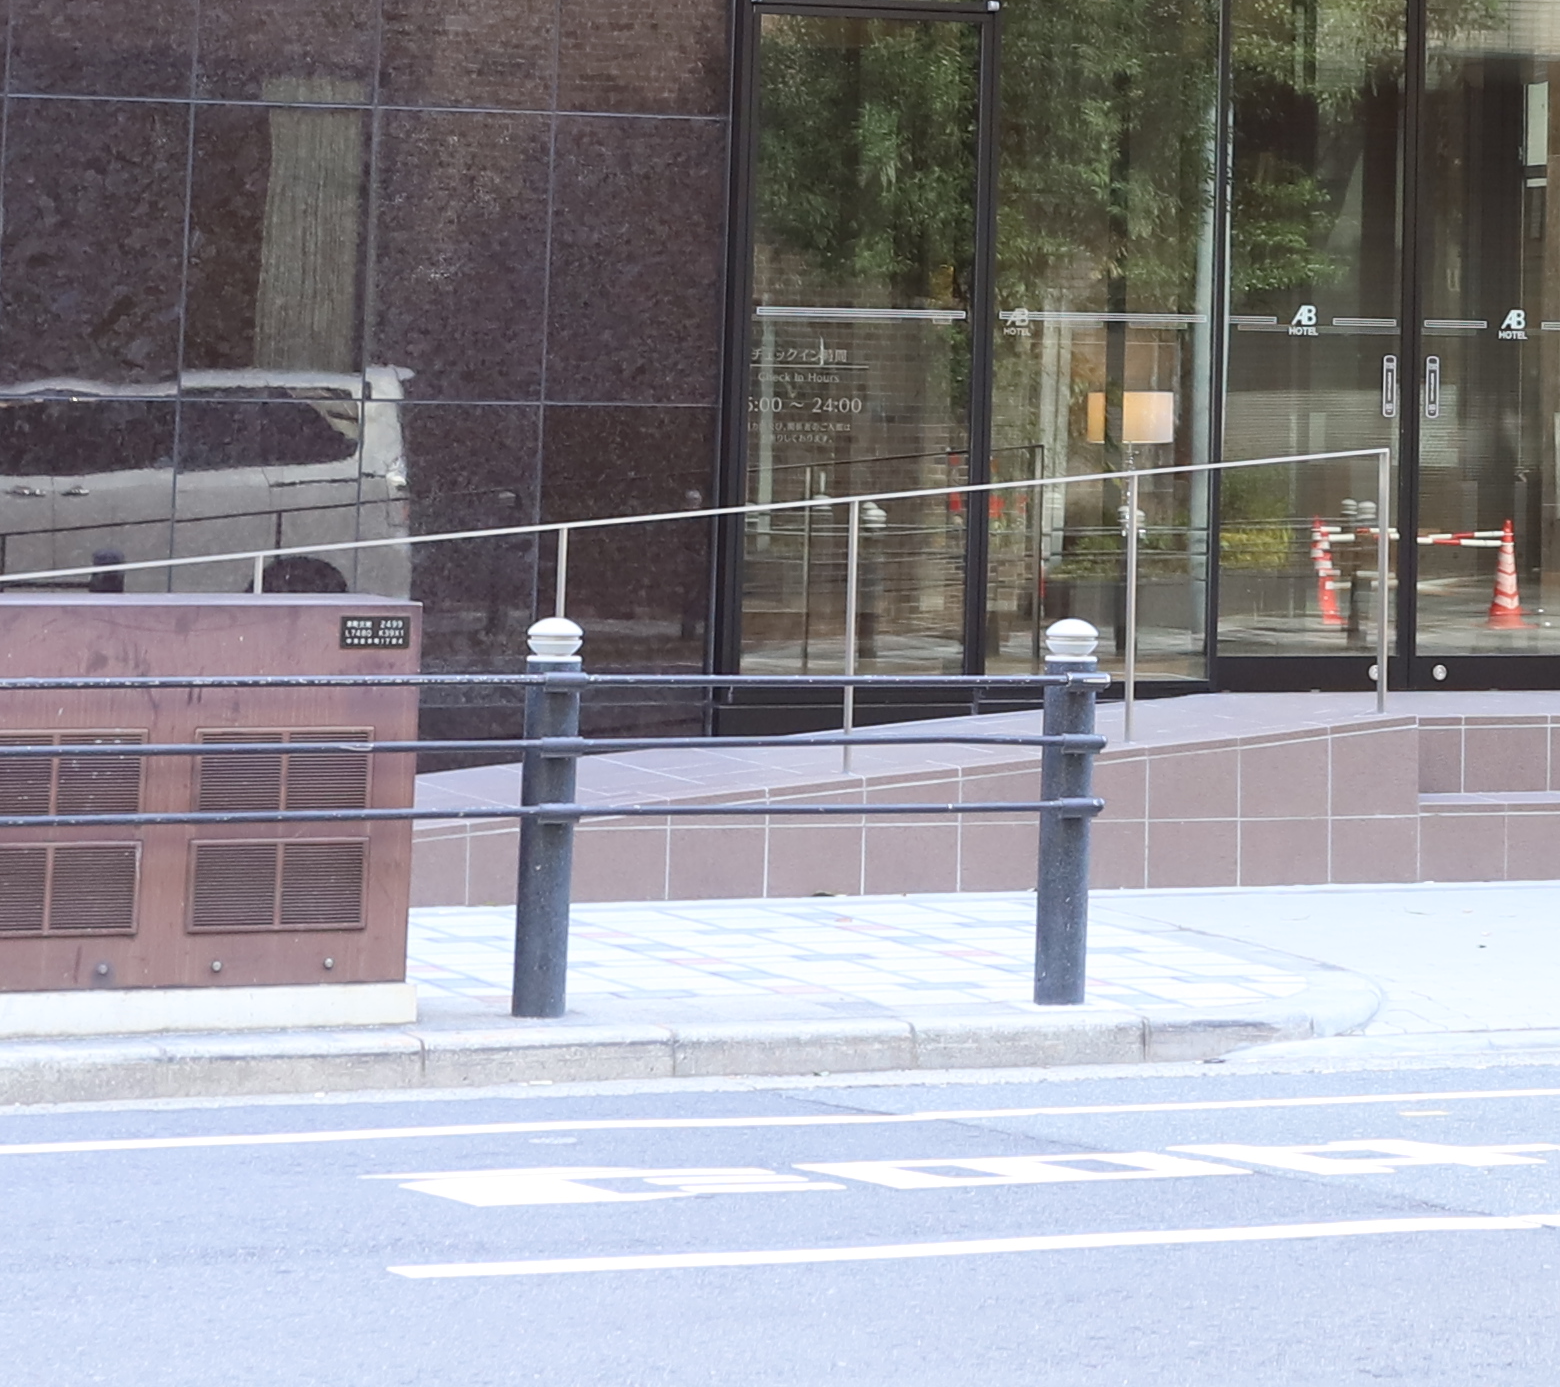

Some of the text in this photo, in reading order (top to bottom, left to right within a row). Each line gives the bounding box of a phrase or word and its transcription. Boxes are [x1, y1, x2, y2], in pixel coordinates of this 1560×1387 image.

[1291, 305, 1317, 326] AB
[1501, 309, 1526, 330] AB
[1003, 327, 1032, 336] HOTEL
[1288, 326, 1319, 336] HOTEL
[1498, 330, 1528, 340] HOTEL
[808, 372, 840, 383] Hours
[811, 397, 862, 414] 24:00
